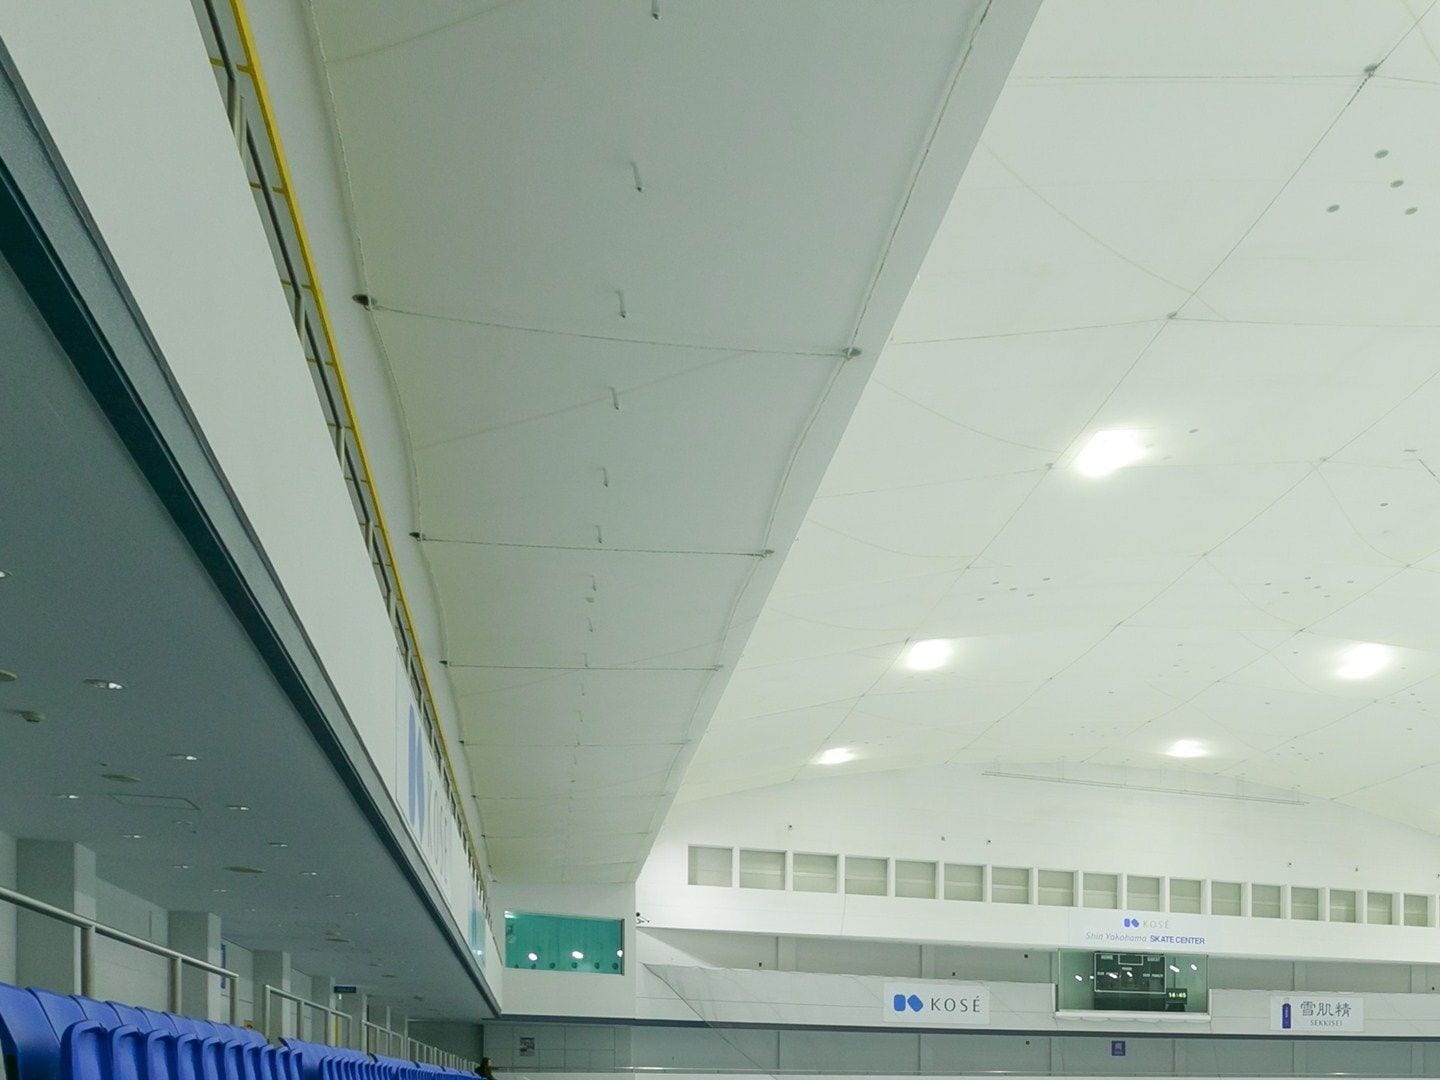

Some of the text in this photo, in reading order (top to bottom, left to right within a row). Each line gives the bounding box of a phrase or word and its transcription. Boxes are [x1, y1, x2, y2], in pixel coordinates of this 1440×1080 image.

[1142, 919, 1170, 929] KOSÉ
[1150, 935, 1174, 943] SKATE
[1175, 936, 1205, 945] CENTER
[930, 996, 980, 1012] KOSÉ
[1300, 1001, 1351, 1017] 雪肌精
